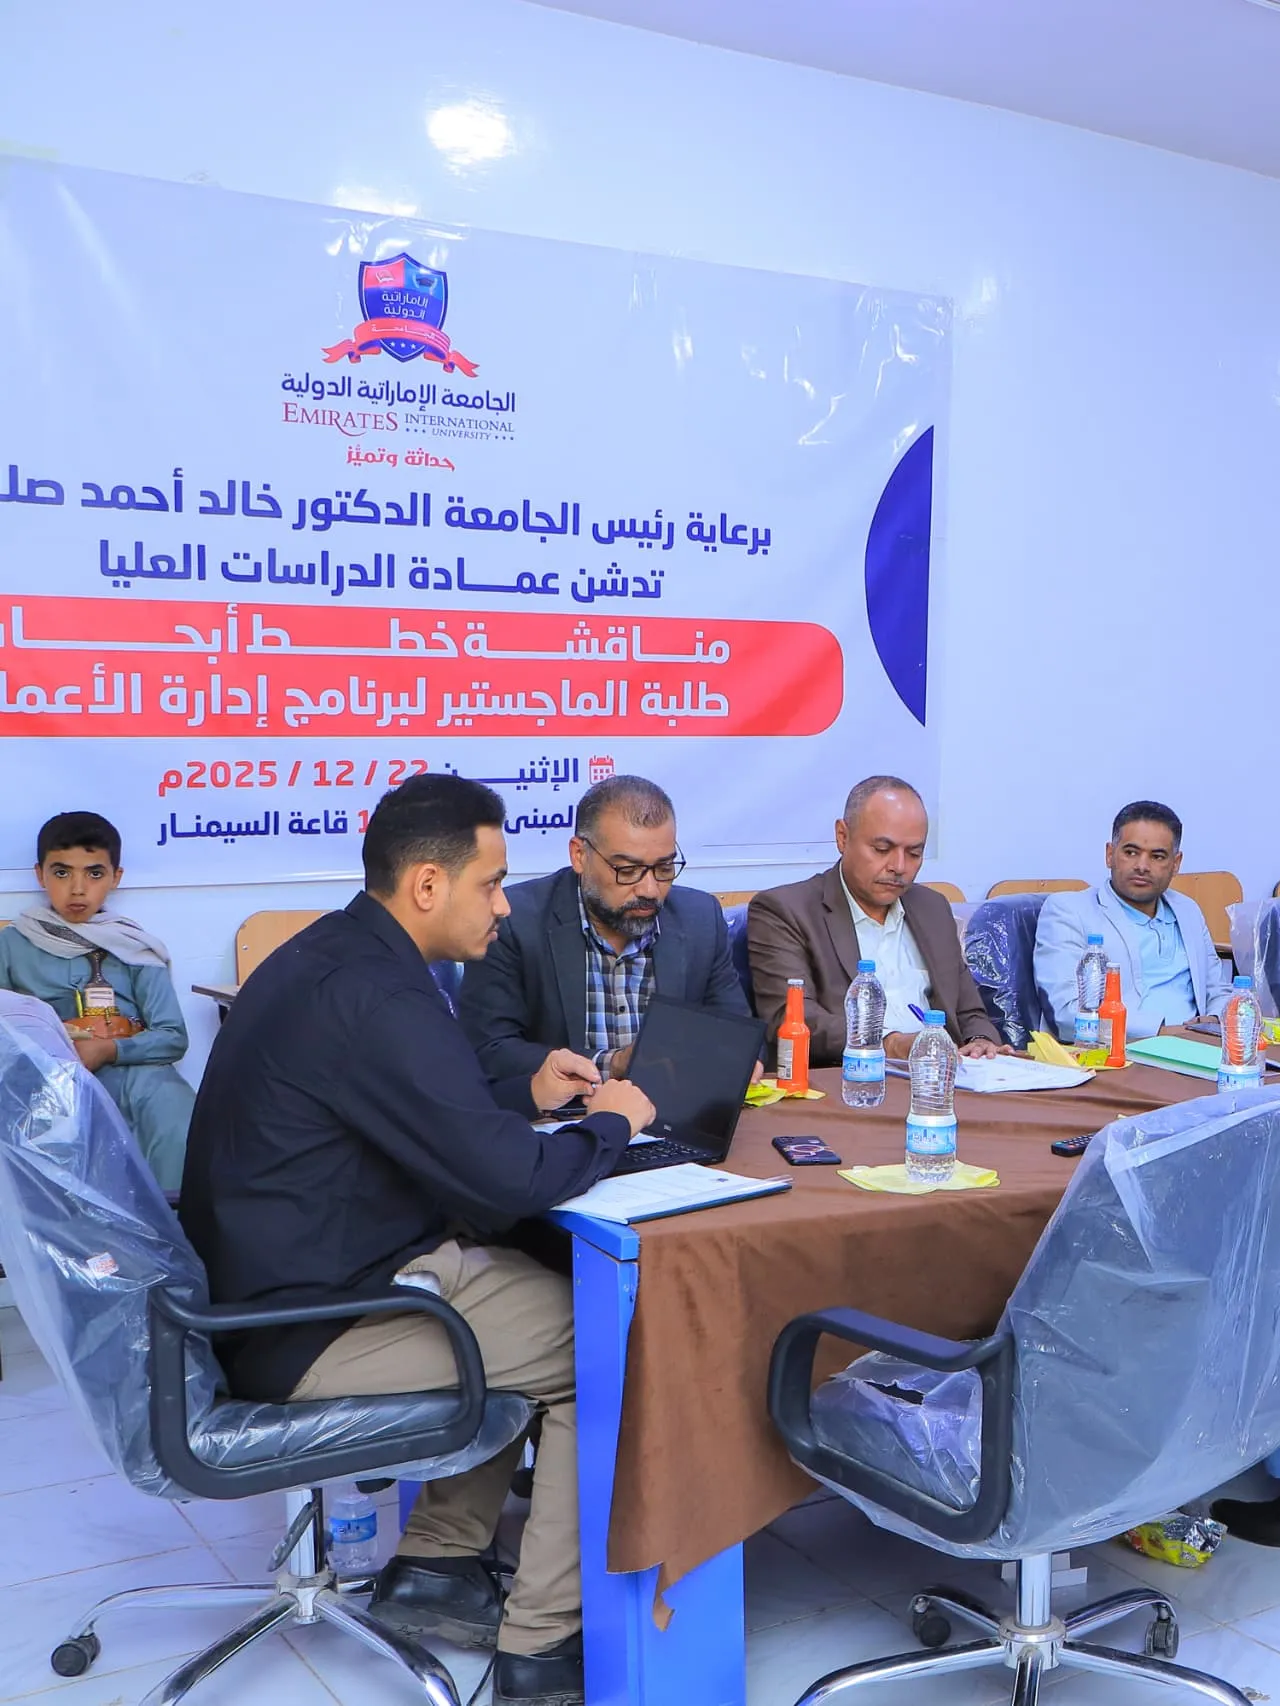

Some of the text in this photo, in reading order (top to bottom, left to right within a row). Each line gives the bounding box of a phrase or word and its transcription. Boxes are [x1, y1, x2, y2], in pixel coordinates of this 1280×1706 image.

[383, 304, 425, 320] الدولية
[281, 372, 515, 416] الجامعة الإماراتية الدولية
[283, 402, 515, 437] EMIRATES INTERNATIONAL
[432, 428, 491, 440] UNIVERSITY
[405, 448, 455, 471] حداثة
[0, 464, 771, 555] برعاية رئيس الجامعة الدكتور خالد أحمد صل
[100, 540, 664, 603] تدشن عمادة الدراسات العليا
[0, 604, 730, 664] مناقشة خطط أبحا
[0, 663, 728, 727] طلبة الماجستير لبرنامج إدارة الأعما
[159, 761, 277, 797] 2025م
[288, 761, 302, 786] /
[314, 760, 354, 786] 12
[364, 760, 377, 785] /
[445, 756, 578, 791] الإثني
[157, 811, 279, 846] السيمنار
[288, 810, 347, 834] قاعة
[504, 805, 579, 835] لمبنى
